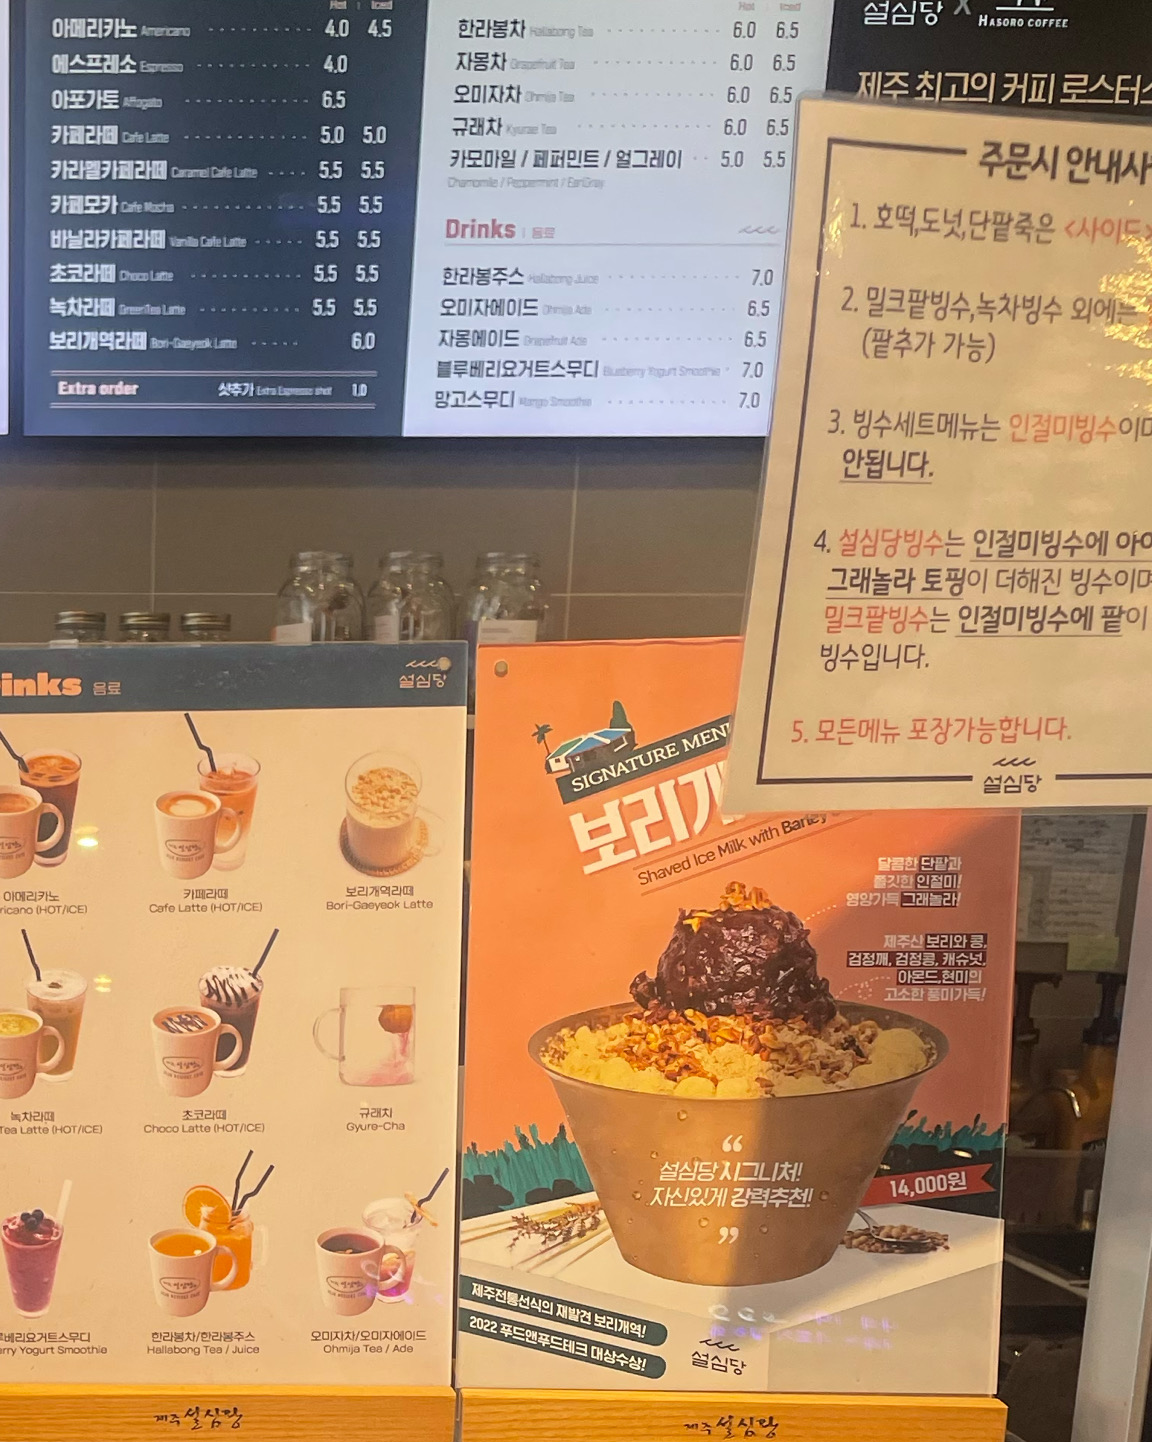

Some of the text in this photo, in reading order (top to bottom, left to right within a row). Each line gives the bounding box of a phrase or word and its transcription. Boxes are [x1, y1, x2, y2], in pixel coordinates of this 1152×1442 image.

[864, 1, 943, 25] 설심당
[978, 15, 1068, 28] HASORO COFFEE
[52, 18, 137, 39] 아메리카노
[325, 20, 349, 37] 4.0
[368, 20, 392, 37] 4.5
[458, 19, 799, 39] 한라봉차 6.0 6.5
[52, 54, 137, 74] 에스프레소
[455, 52, 506, 72] 자몽차
[454, 85, 521, 104] 오미자차
[914, 71, 1055, 104] 최고의 커피
[51, 125, 118, 144] 카페라떼
[452, 118, 502, 136] 규래차
[979, 140, 1059, 181] 주문시
[446, 219, 516, 239] Drinks
[850, 203, 1056, 244] 1. 호떡,도넛,단팥죽은
[442, 267, 524, 286] 한라봉주스
[440, 298, 539, 316] 오미자에이드
[841, 286, 1063, 323] 2. 밀크팥빙수,녹차빙수
[439, 329, 520, 347] 자몽에이드
[862, 327, 995, 364] (팥추가 가능)
[828, 410, 1000, 443] 3. 빙수세트메뉴는
[842, 449, 934, 479] 안됩니다.
[814, 529, 1109, 559] 4. 설심당빙수는 인절미빙수에
[827, 567, 1062, 596] 그래놀라 토핑이 더해진
[825, 605, 1148, 634] 밀크팥빙수는 인절미빙수에 팥이
[821, 644, 929, 672] 빙수입니다.
[93, 680, 121, 696] 음료
[399, 673, 449, 689] 설심당
[792, 716, 1072, 745] 5. 모든메뉴 포장가능합니다.
[572, 743, 680, 792] SIGNATURE
[983, 775, 1042, 794] 설심당
[638, 826, 780, 886] Shaved Ice Milk with
[878, 856, 962, 871] 달콤한 단팥과
[3, 891, 60, 902] 아메리카노
[183, 889, 229, 900] 카페라떼
[346, 886, 414, 897] 보리개역라떼
[36, 905, 87, 915] (HOT/ICE)
[327, 900, 433, 911] Bori-Gaeyeok Latte
[10, 1111, 55, 1122] 녹차라떼
[182, 1110, 227, 1121] 초코라떼
[20, 1126, 49, 1135] Latte
[52, 1125, 103, 1135] (HOT/ICE)
[346, 1119, 406, 1133] Gyure-Cha
[658, 1161, 803, 1183] 설심당 시그니처!
[889, 1171, 967, 1199] 14,000원
[649, 1187, 813, 1209] 자신있게 강력추천!
[472, 1282, 647, 1338] 제주전통선식의 재발견 보리개역!
[20, 1346, 54, 1356] Yogurt
[58, 1345, 108, 1355] Smoothie
[469, 1316, 647, 1372] 2022 푸드앤푸드테크 대상수상!
[692, 1350, 747, 1376] 설심당
